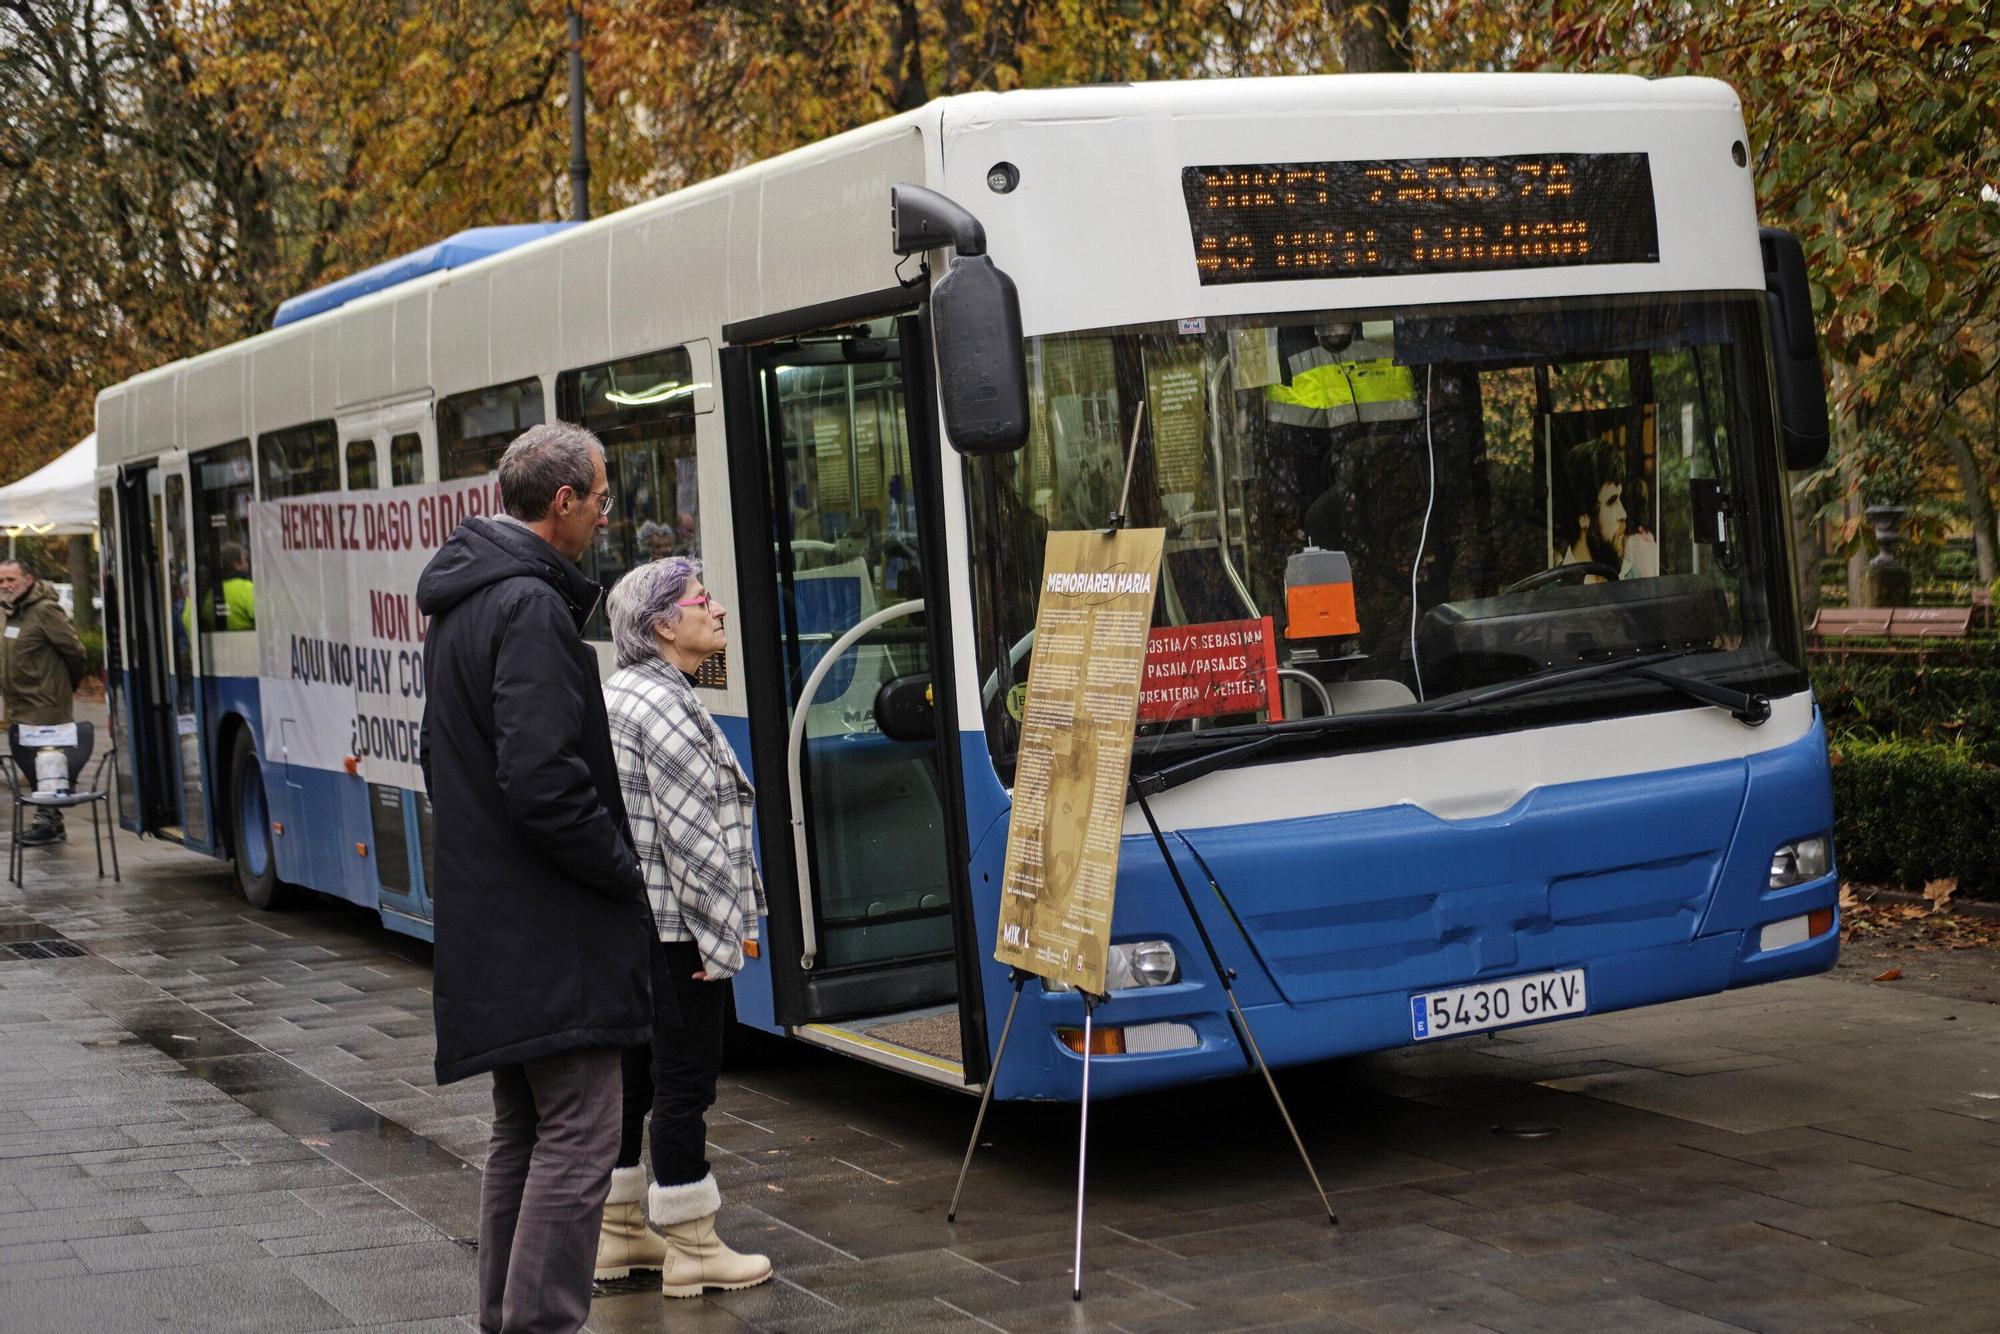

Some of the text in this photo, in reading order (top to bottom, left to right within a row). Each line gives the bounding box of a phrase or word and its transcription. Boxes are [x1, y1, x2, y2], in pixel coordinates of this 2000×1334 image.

[280, 503, 335, 550] HEMEN
[337, 503, 360, 550] EZ
[363, 500, 412, 551] DAGO
[1046, 573, 1151, 593] MEMORIAREN HARIA
[369, 589, 410, 643] NON
[291, 634, 327, 686] AQUI
[330, 640, 353, 687] NO
[356, 646, 391, 695] HAY
[1003, 922, 1030, 949] MIKL
[1416, 975, 1576, 1031] E 5430 GKV
